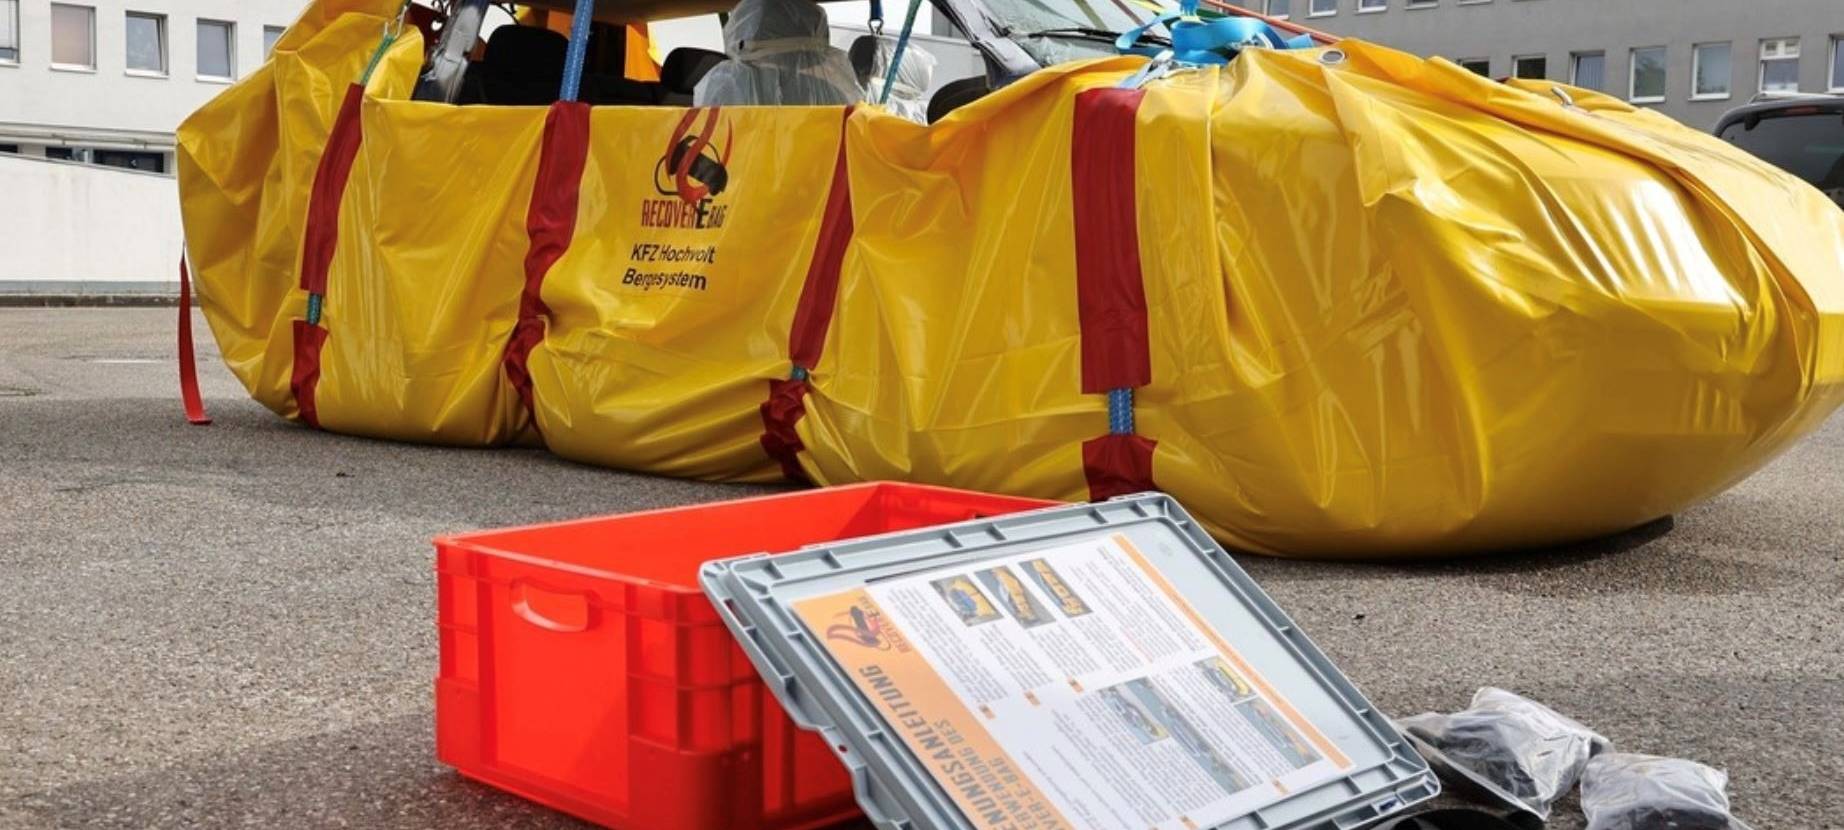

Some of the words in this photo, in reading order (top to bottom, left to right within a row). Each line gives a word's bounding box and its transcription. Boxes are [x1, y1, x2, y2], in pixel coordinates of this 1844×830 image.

[631, 243, 660, 262] KFZ
[659, 245, 715, 264] Hochvolt
[622, 268, 707, 290] Bergesystem
[935, 719, 964, 745] DES
[990, 757, 1065, 830] VER-E-BAG
